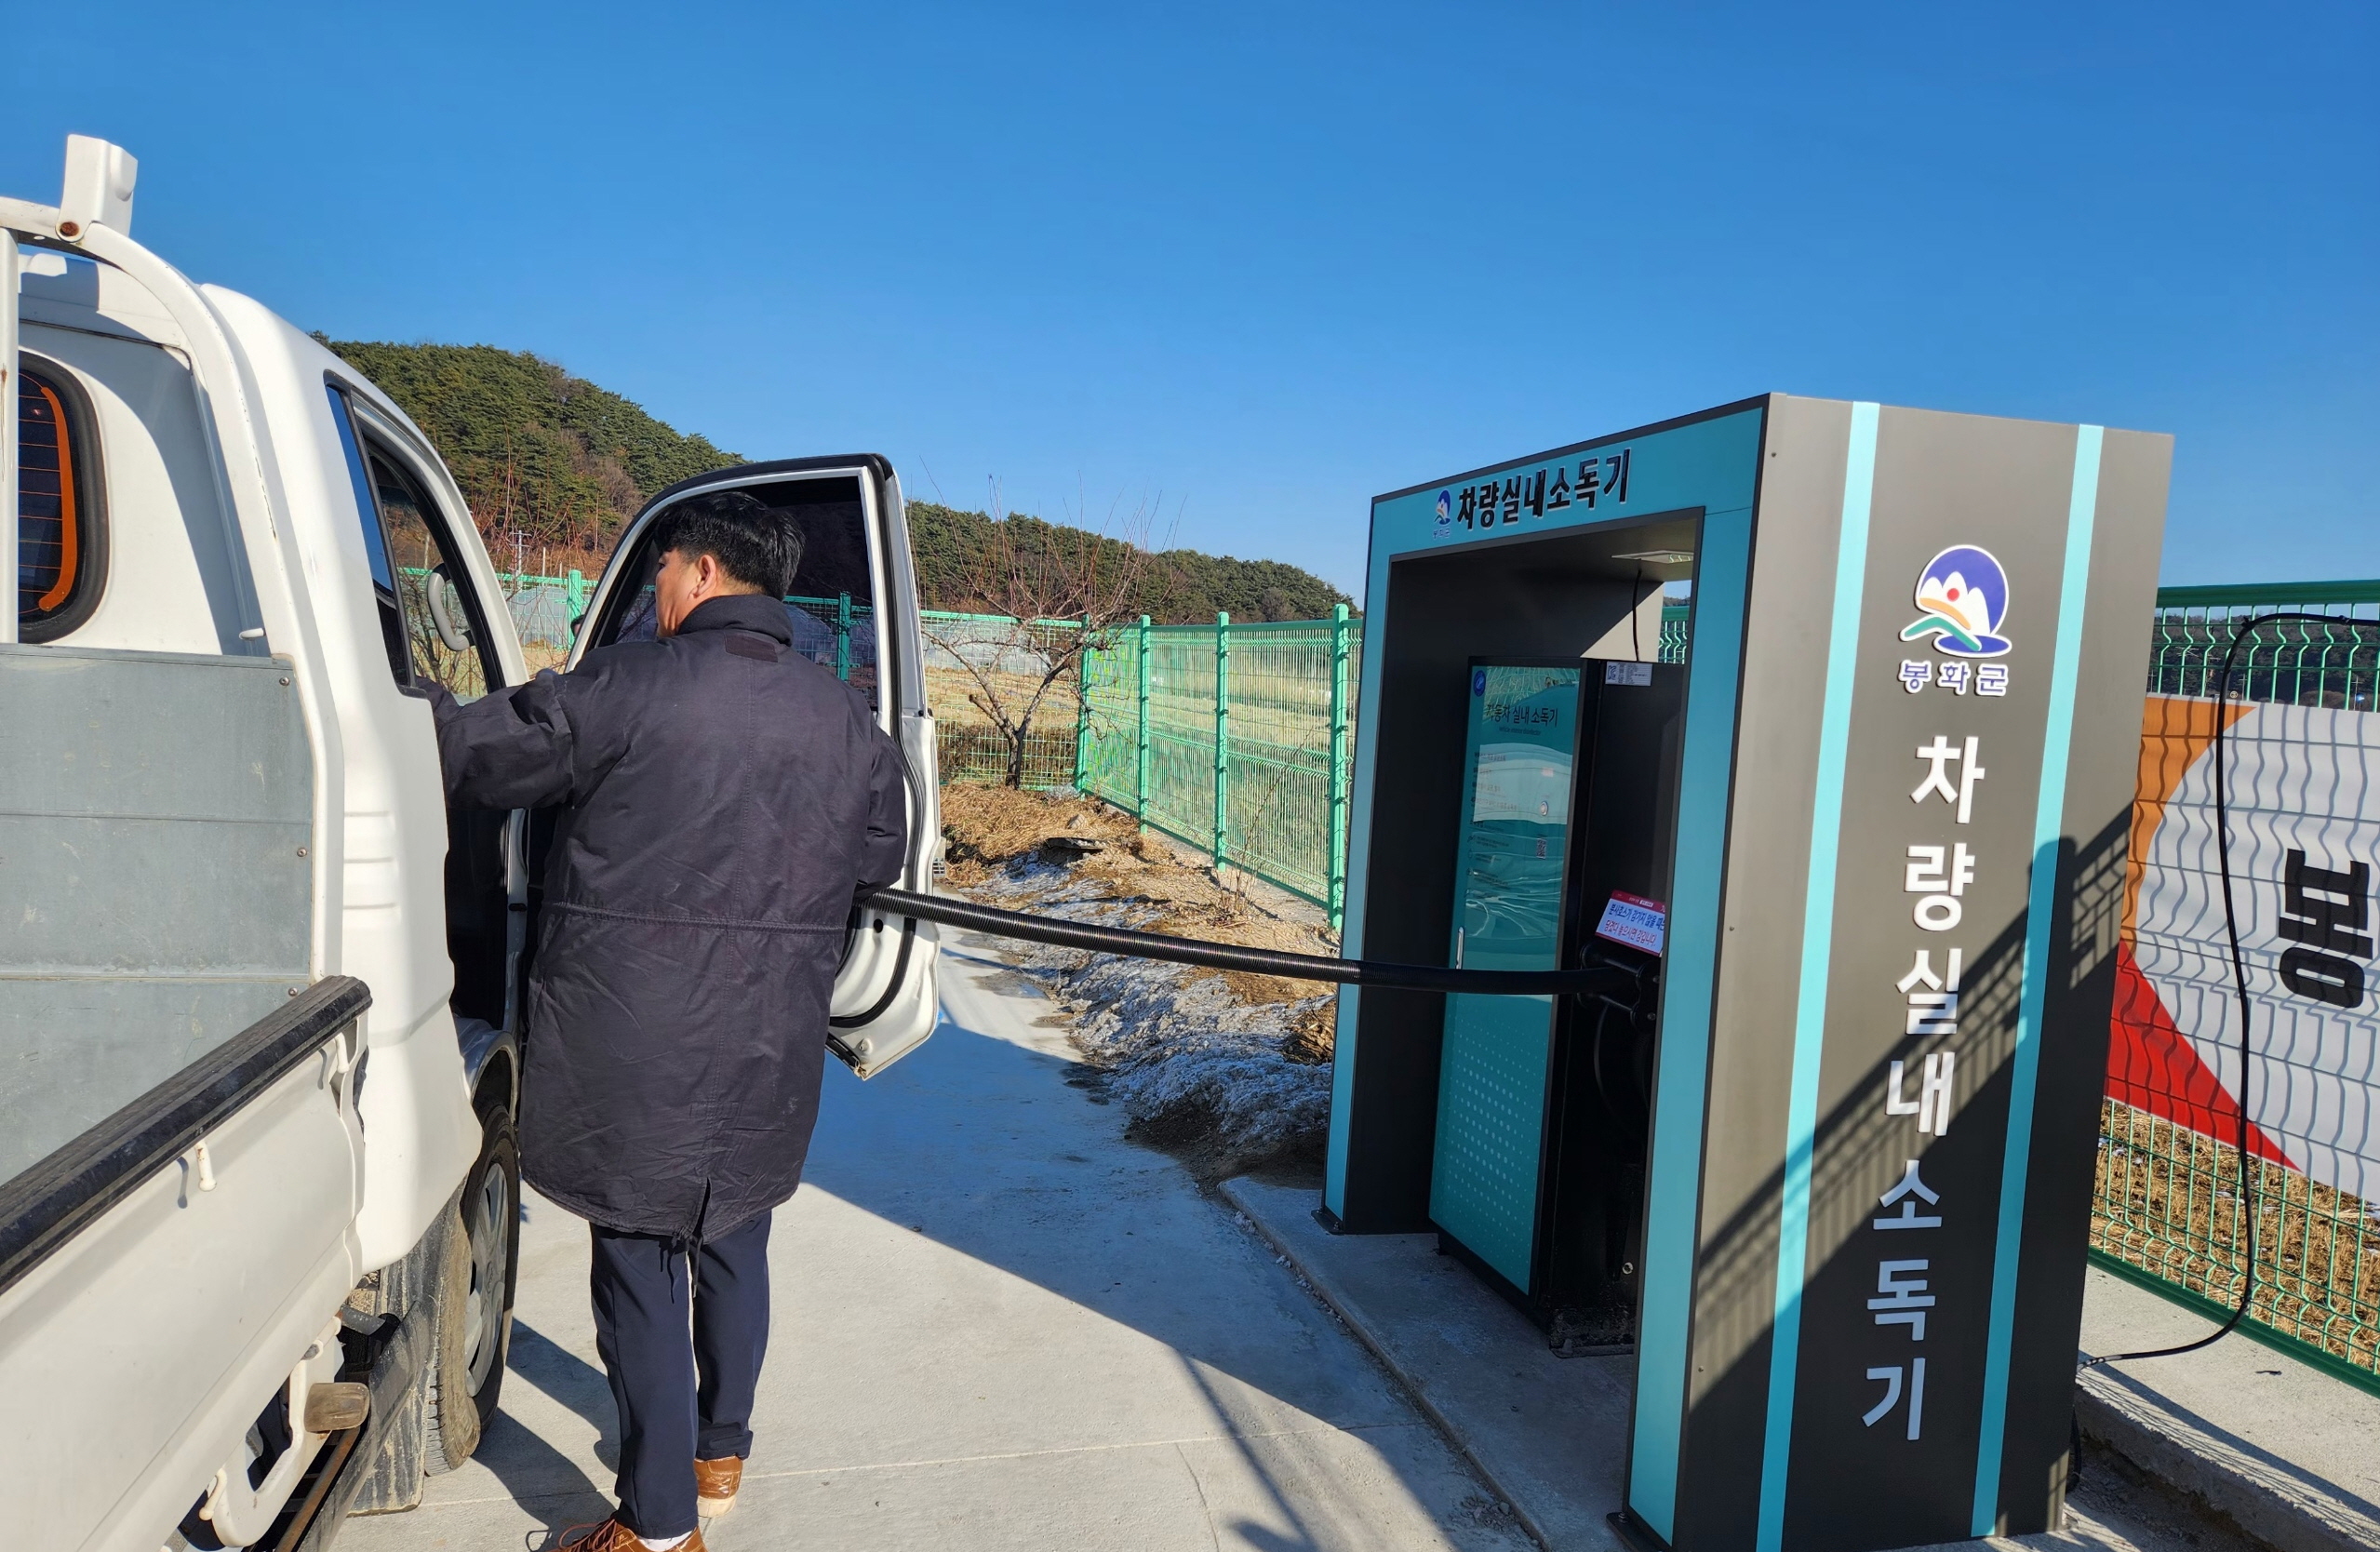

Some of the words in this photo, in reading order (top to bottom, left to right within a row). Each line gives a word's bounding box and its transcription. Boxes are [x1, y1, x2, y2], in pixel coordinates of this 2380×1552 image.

[1457, 448, 1631, 530] 차량실내소독기
[1898, 659, 2009, 697] 봉화군
[1512, 705, 1530, 725] 실내
[1531, 707, 1558, 728] 소독기
[1644, 914, 1657, 928] 않을
[2279, 848, 2374, 1009] 봉
[1862, 735, 1986, 1441] 차량실내소독기
